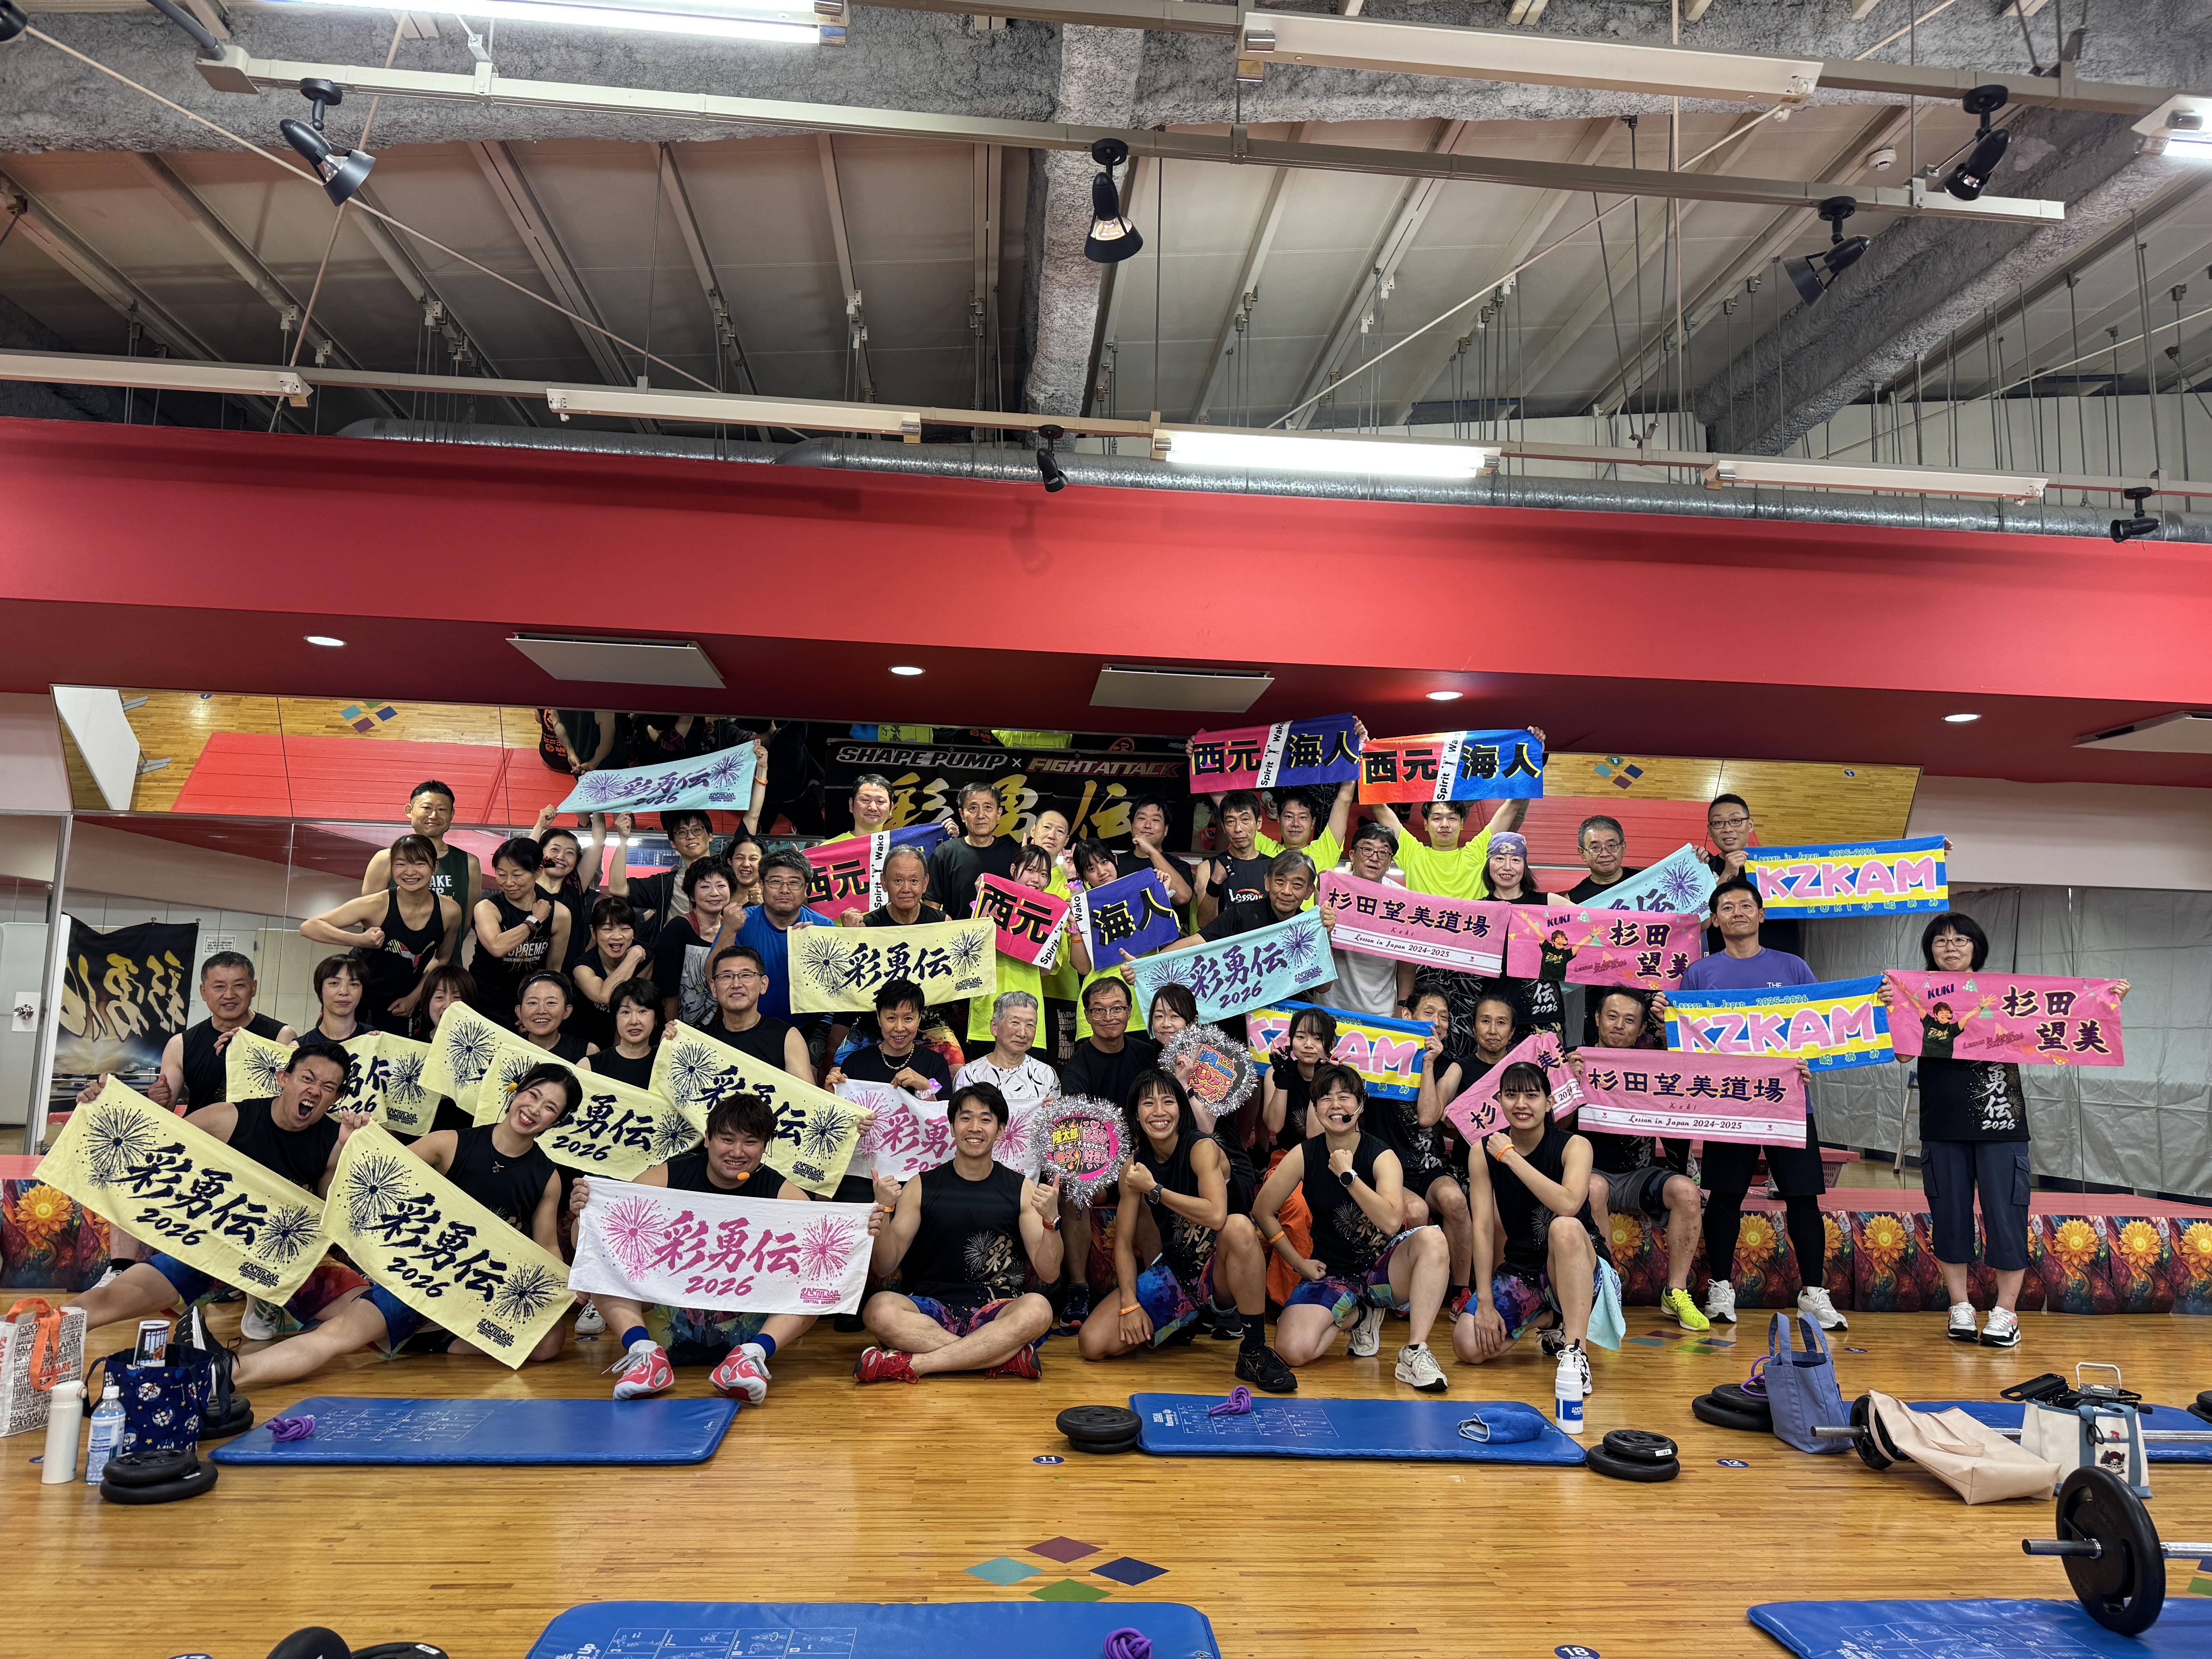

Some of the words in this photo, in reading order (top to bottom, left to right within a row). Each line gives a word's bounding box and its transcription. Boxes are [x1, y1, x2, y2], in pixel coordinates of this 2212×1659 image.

[836, 746, 929, 766] SHAPE
[929, 750, 1008, 770] PUMP
[1029, 757, 1098, 775] FIGHT
[1094, 761, 1186, 778] ATTACK
[1193, 740, 1261, 775] 西元
[1285, 730, 1360, 768] 海人
[1460, 743, 1542, 781] 海人
[1261, 761, 1274, 787] Spirit
[1362, 749, 1438, 784] 西元
[633, 791, 678, 806] 2026
[1437, 773, 1450, 800] Spirit
[875, 834, 884, 860] Wako
[1754, 854, 1780, 862] Lesson
[1796, 852, 1819, 861] Japan
[1829, 848, 1876, 857] 2025-2026
[429, 875, 452, 887] AKE
[1757, 855, 1937, 900] KZKAM
[874, 882, 883, 908] Spirit
[1074, 895, 1082, 922] Wako
[1092, 888, 1173, 946] 海人
[1328, 887, 1492, 938] 杉田望美道場
[1547, 914, 1571, 927] KUKI
[1355, 934, 1374, 944] Lesson
[1385, 940, 1405, 950] Japan
[1409, 944, 1449, 958] 2024-2025
[1608, 918, 1670, 947] 杉田
[1040, 938, 1059, 965] Spirit
[1636, 951, 1689, 979] 望美
[840, 942, 953, 993] 彩勇伝
[1189, 942, 1288, 1003] 彩勇伝
[1218, 981, 1263, 1010] 2026
[1673, 1000, 1702, 1009] Lesson
[1706, 1000, 1715, 1008] in
[1721, 1000, 1746, 1010] Japan
[1755, 994, 1808, 1007] 2025-2026
[1927, 983, 1955, 999] KUKI
[2001, 984, 2077, 1018] 杉田
[1532, 1001, 1558, 1015] 2026
[1677, 1001, 1877, 1055] KZKAM
[2035, 1019, 2111, 1054] 望美
[1588, 1067, 1787, 1103] 杉田望美道場
[553, 1093, 658, 1152] 勇伝
[878, 1103, 956, 1157] 彩勇
[1082, 1127, 1108, 1143] はるか
[1628, 1115, 1652, 1124] Lesson
[1666, 1118, 1690, 1127] Japan
[1693, 1119, 1742, 1130] 2024-2025
[1981, 1119, 2016, 1131] 2026
[549, 1135, 613, 1161] 2026
[1058, 1143, 1073, 1151] もっと
[1084, 1149, 1101, 1162] 好き
[113, 1142, 269, 1246] 彩勇伝
[131, 1207, 209, 1246] 2026
[364, 1192, 508, 1302] 彩勇伝
[647, 1210, 802, 1277] 彩勇伝
[383, 1257, 451, 1298] 2026
[682, 1275, 757, 1297] 2026
[1561, 1647, 1590, 1656] 18
